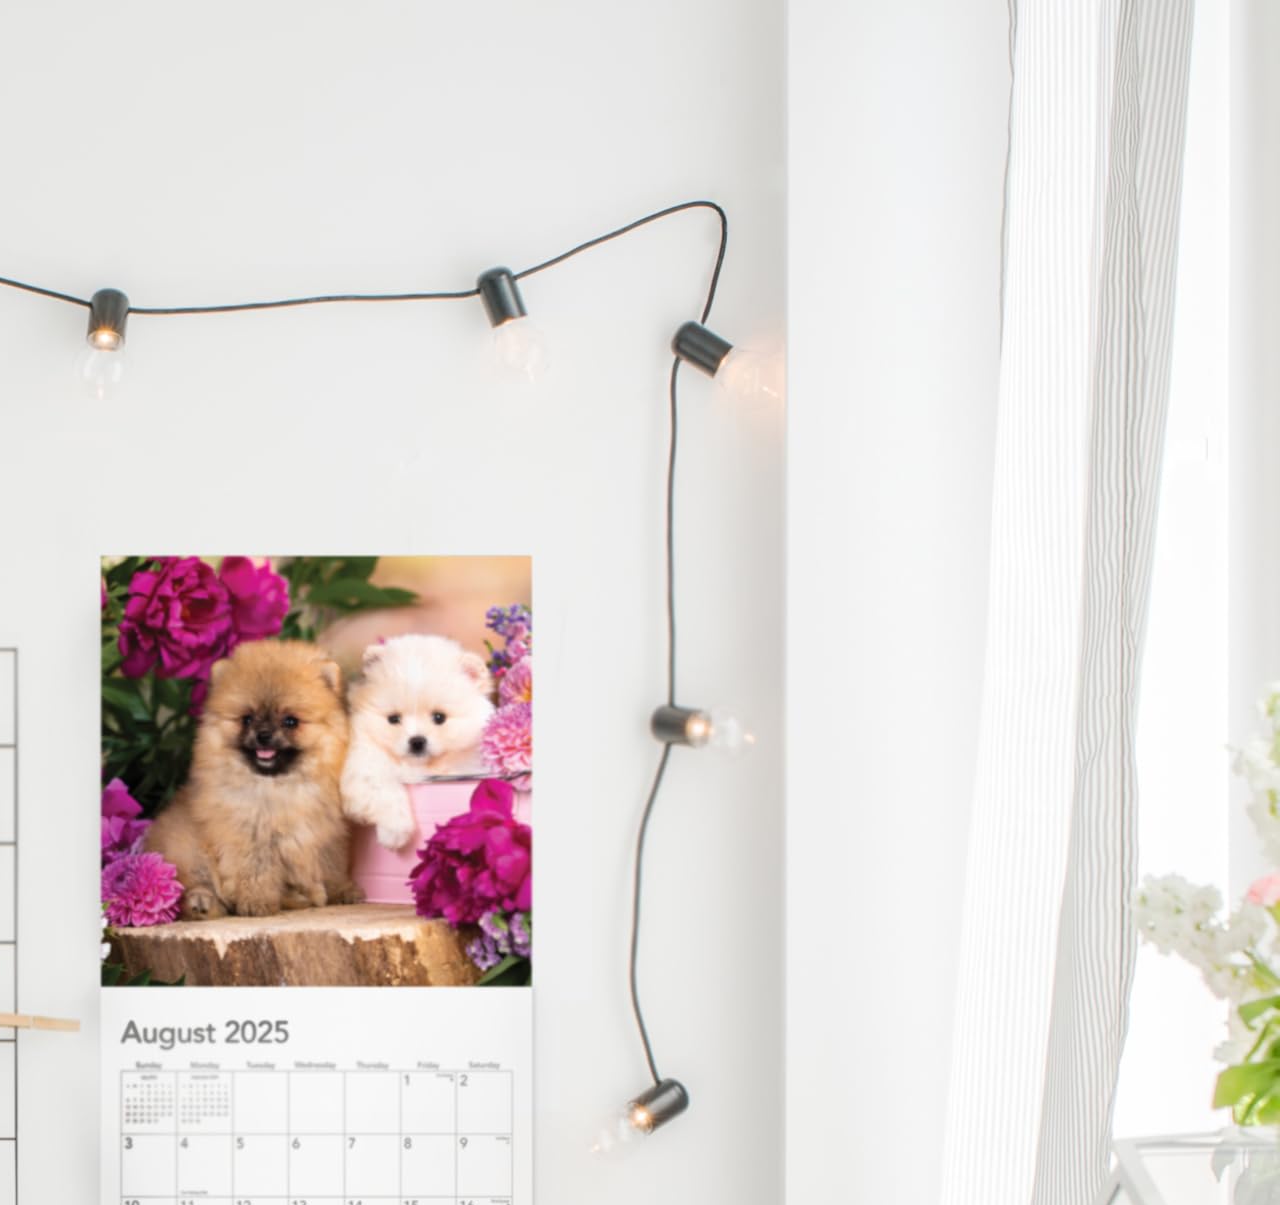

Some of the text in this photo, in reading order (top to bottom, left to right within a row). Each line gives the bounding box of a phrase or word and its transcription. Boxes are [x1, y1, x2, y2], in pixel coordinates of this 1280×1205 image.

[120, 1019, 290, 1051] August 2025
[245, 1060, 276, 1071] Tuesday
[293, 1060, 337, 1071] Wednesday
[355, 1060, 390, 1071] Thursday
[416, 1060, 440, 1071] Friday
[468, 1060, 501, 1071] Saturday
[404, 1073, 469, 1087] 1 2
[124, 1136, 469, 1150] 3 4 5 6 7 8 9
